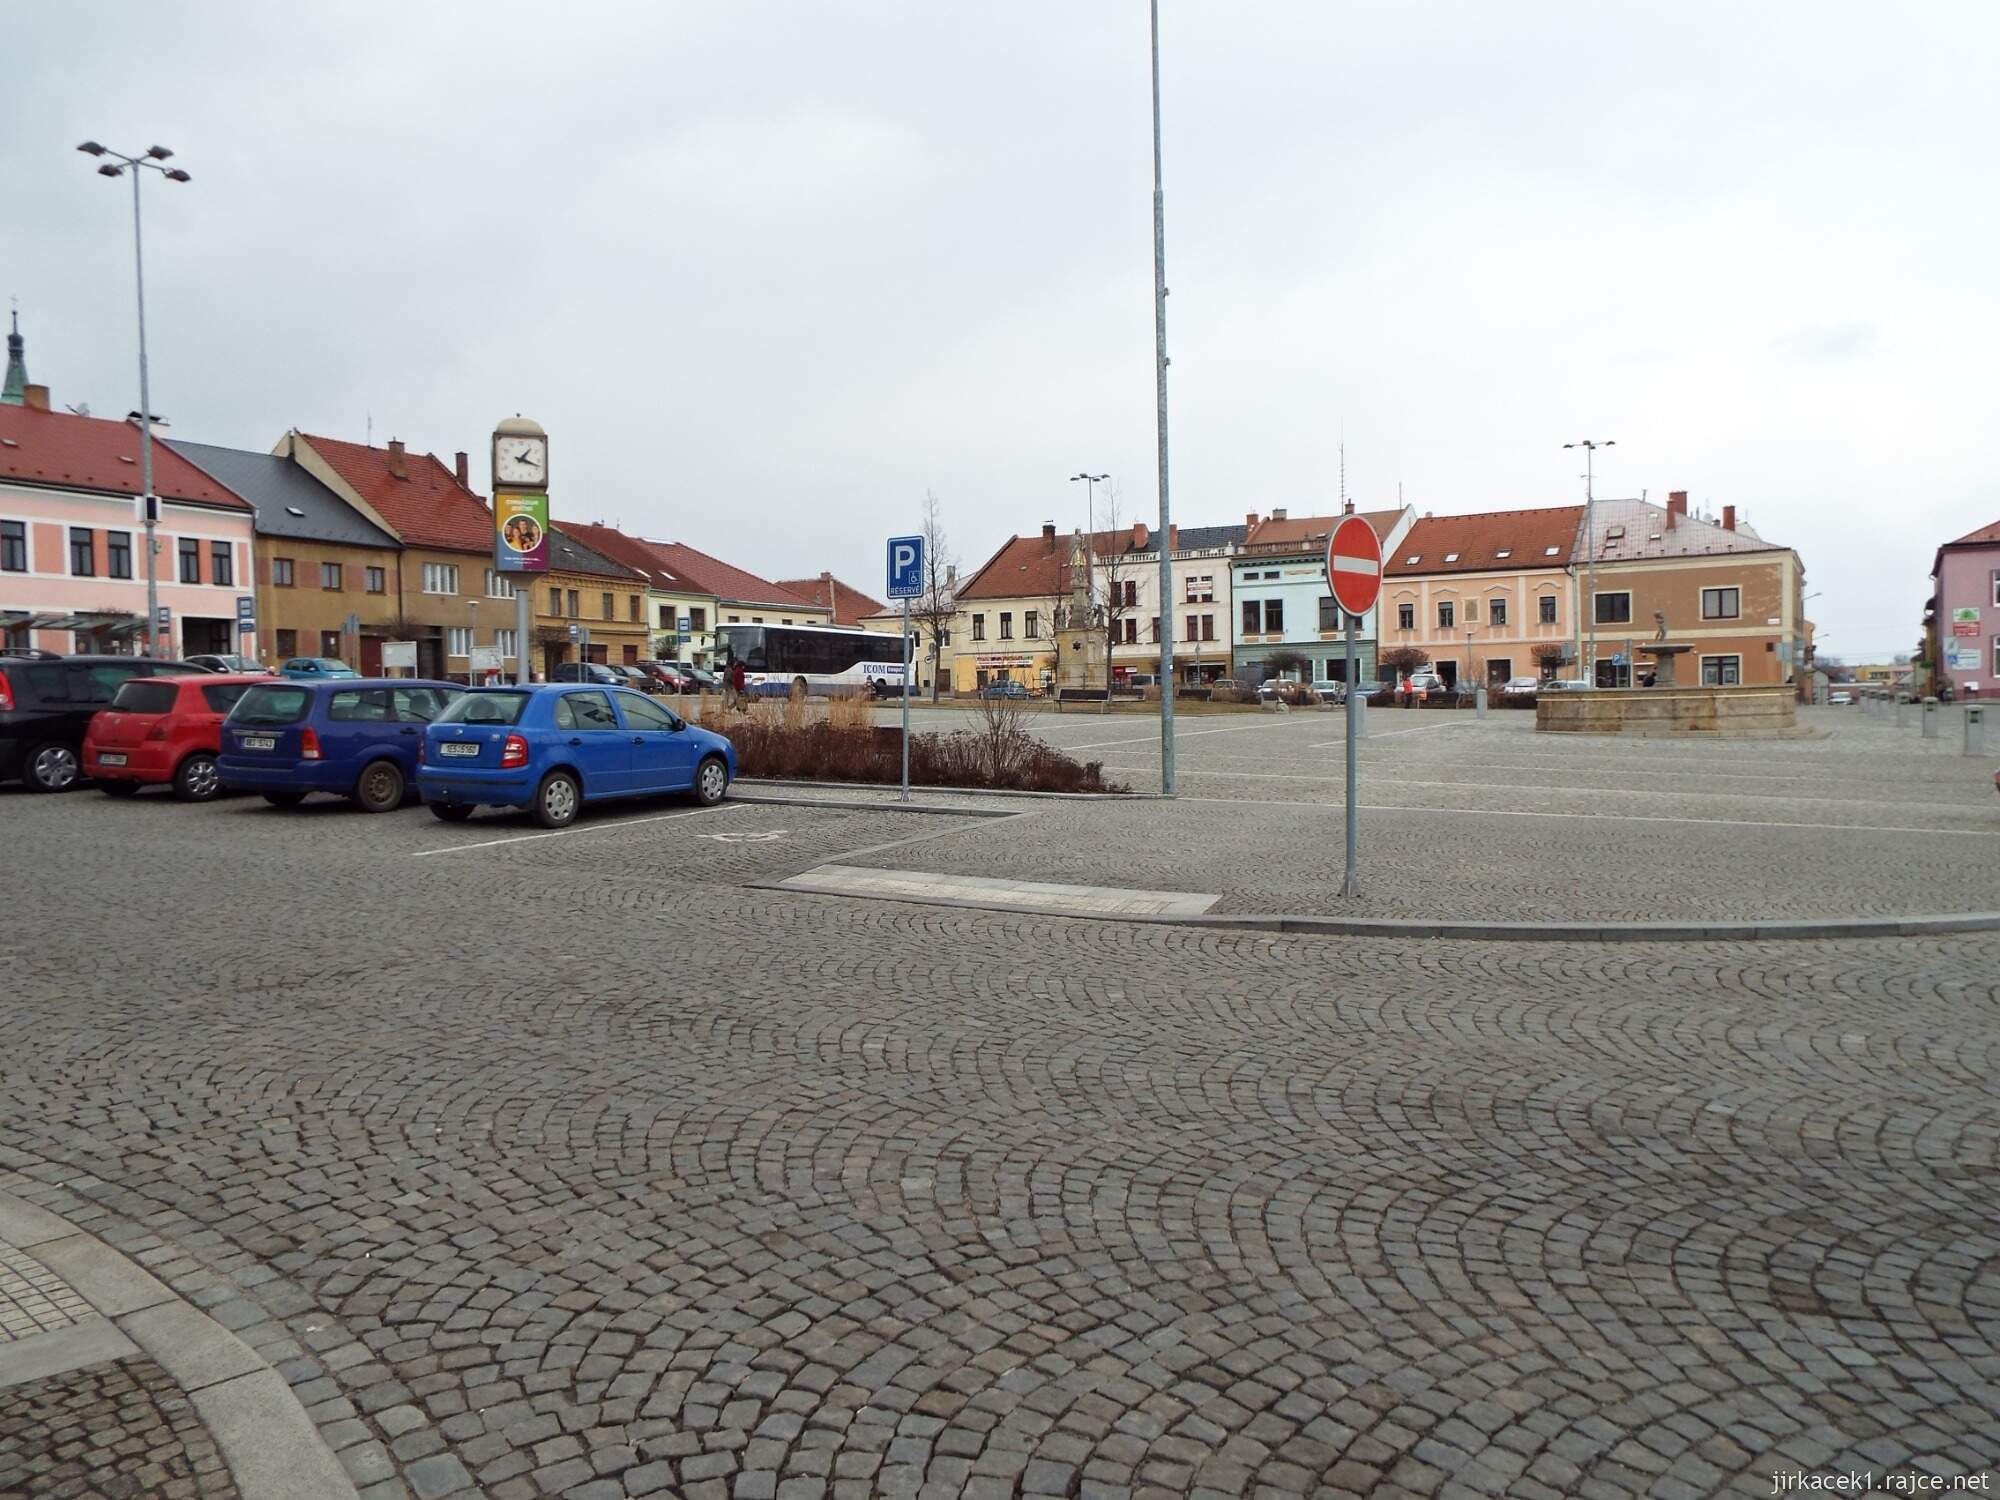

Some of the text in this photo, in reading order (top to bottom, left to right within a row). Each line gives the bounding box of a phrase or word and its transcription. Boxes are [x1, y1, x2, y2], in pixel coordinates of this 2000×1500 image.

[895, 545, 915, 579] P
[890, 585, 920, 595] RÉSERVÉ
[863, 664, 886, 674] ICOM
